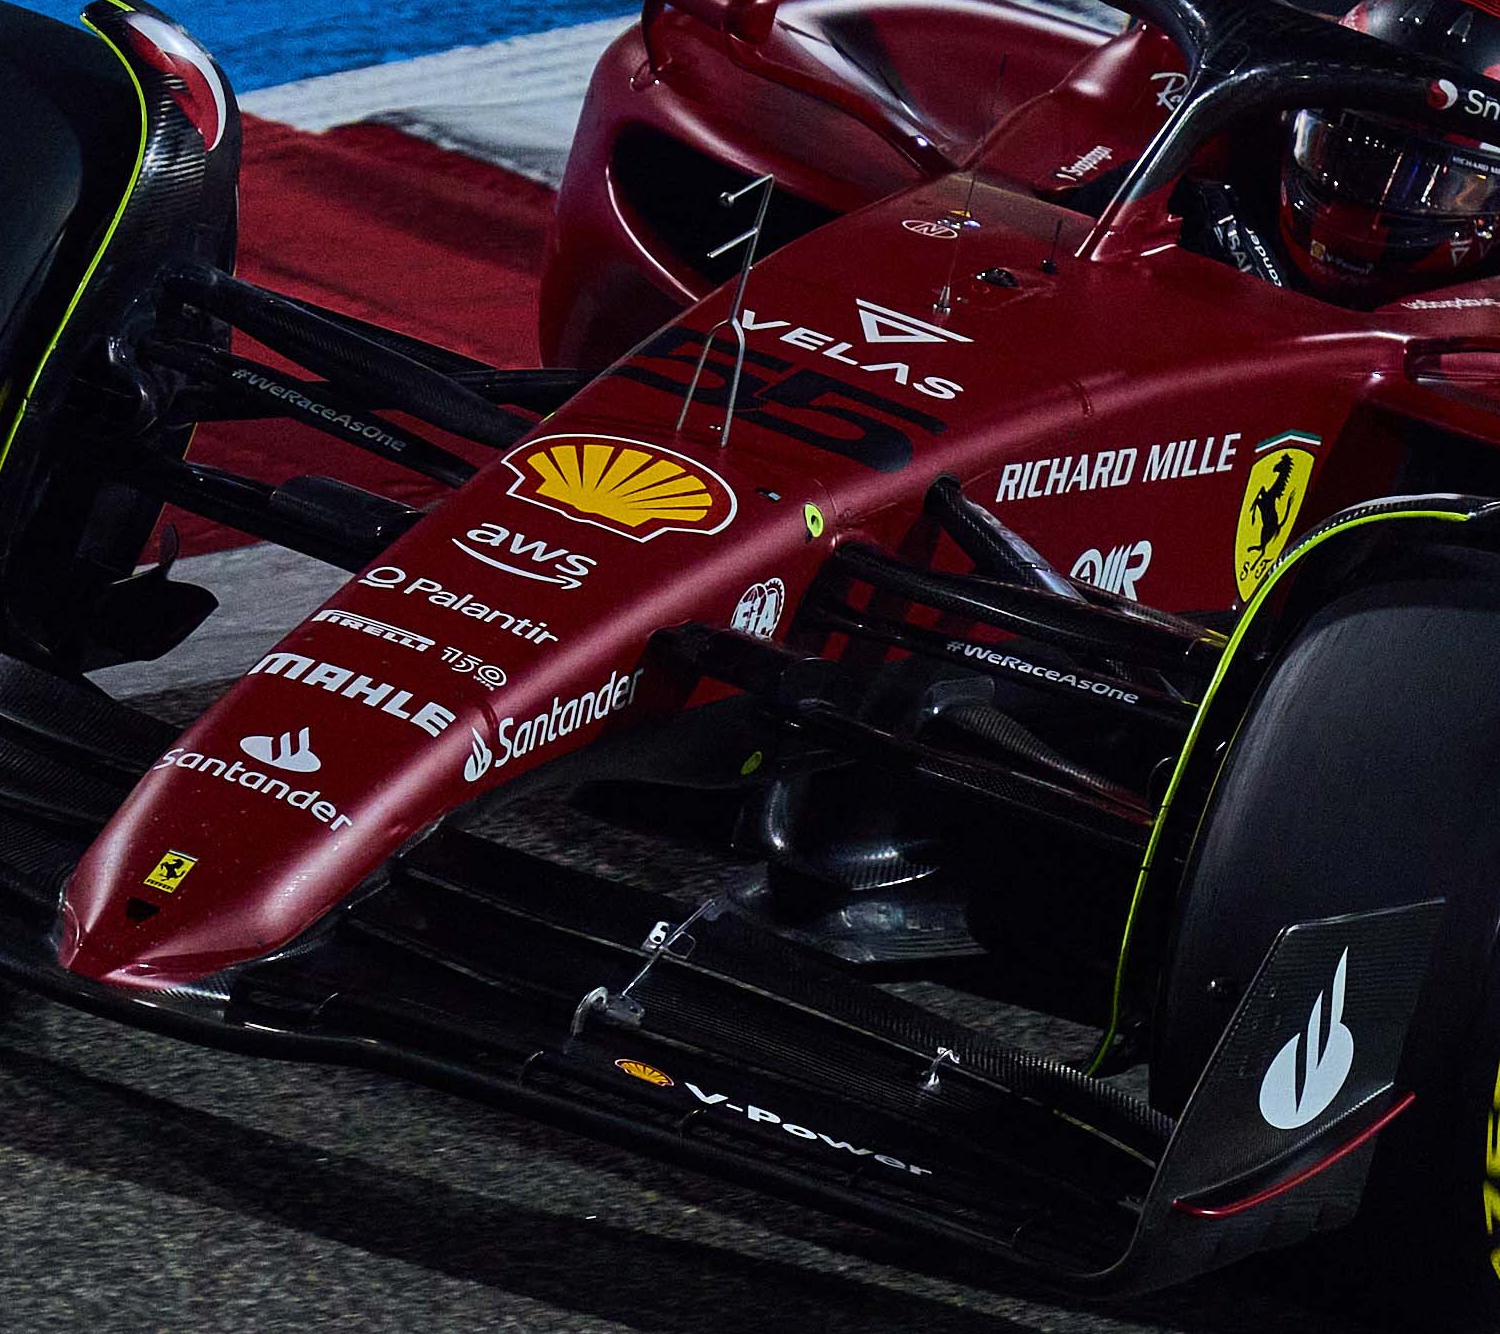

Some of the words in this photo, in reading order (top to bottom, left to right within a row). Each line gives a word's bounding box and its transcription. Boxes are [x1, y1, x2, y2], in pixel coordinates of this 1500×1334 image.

[232, 368, 407, 451] #WeRaceAsOne
[611, 328, 948, 472] 55
[996, 443, 1141, 503] RICHARD
[1141, 433, 1243, 482] MILLE
[466, 522, 598, 578] aws
[311, 609, 436, 652] PIRELLI
[404, 576, 559, 647] Palantir
[248, 652, 456, 738] MAHLE
[441, 647, 507, 688] 150
[947, 640, 1140, 704] #WeRaceAsOne
[495, 668, 645, 768] Santander
[153, 747, 354, 832] Santander
[684, 1082, 932, 1177] V-Power
